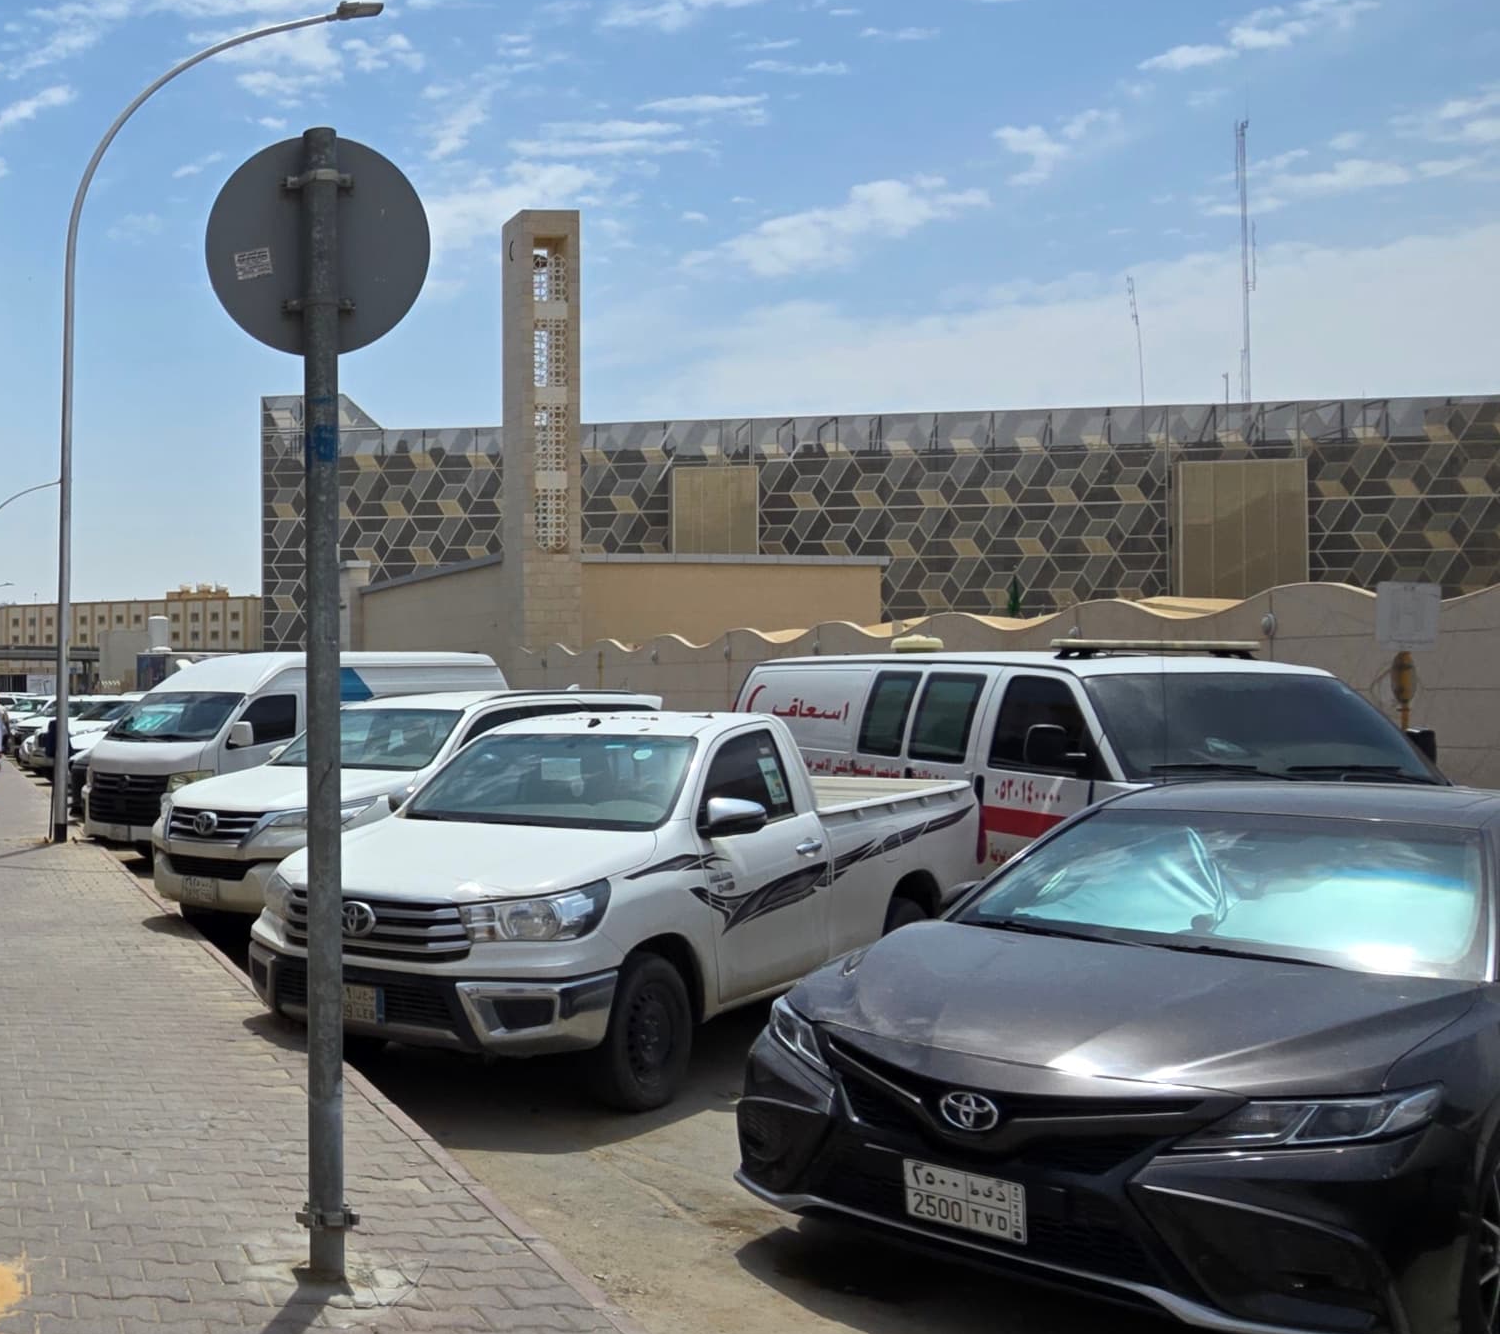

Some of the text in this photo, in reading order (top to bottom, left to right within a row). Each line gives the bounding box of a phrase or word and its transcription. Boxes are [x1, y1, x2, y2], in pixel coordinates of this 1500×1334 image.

[771, 698, 850, 725] اسعاف
[912, 1165, 959, 1188] ٢٥٠٠
[913, 1192, 1008, 1232] 2500 TVD
